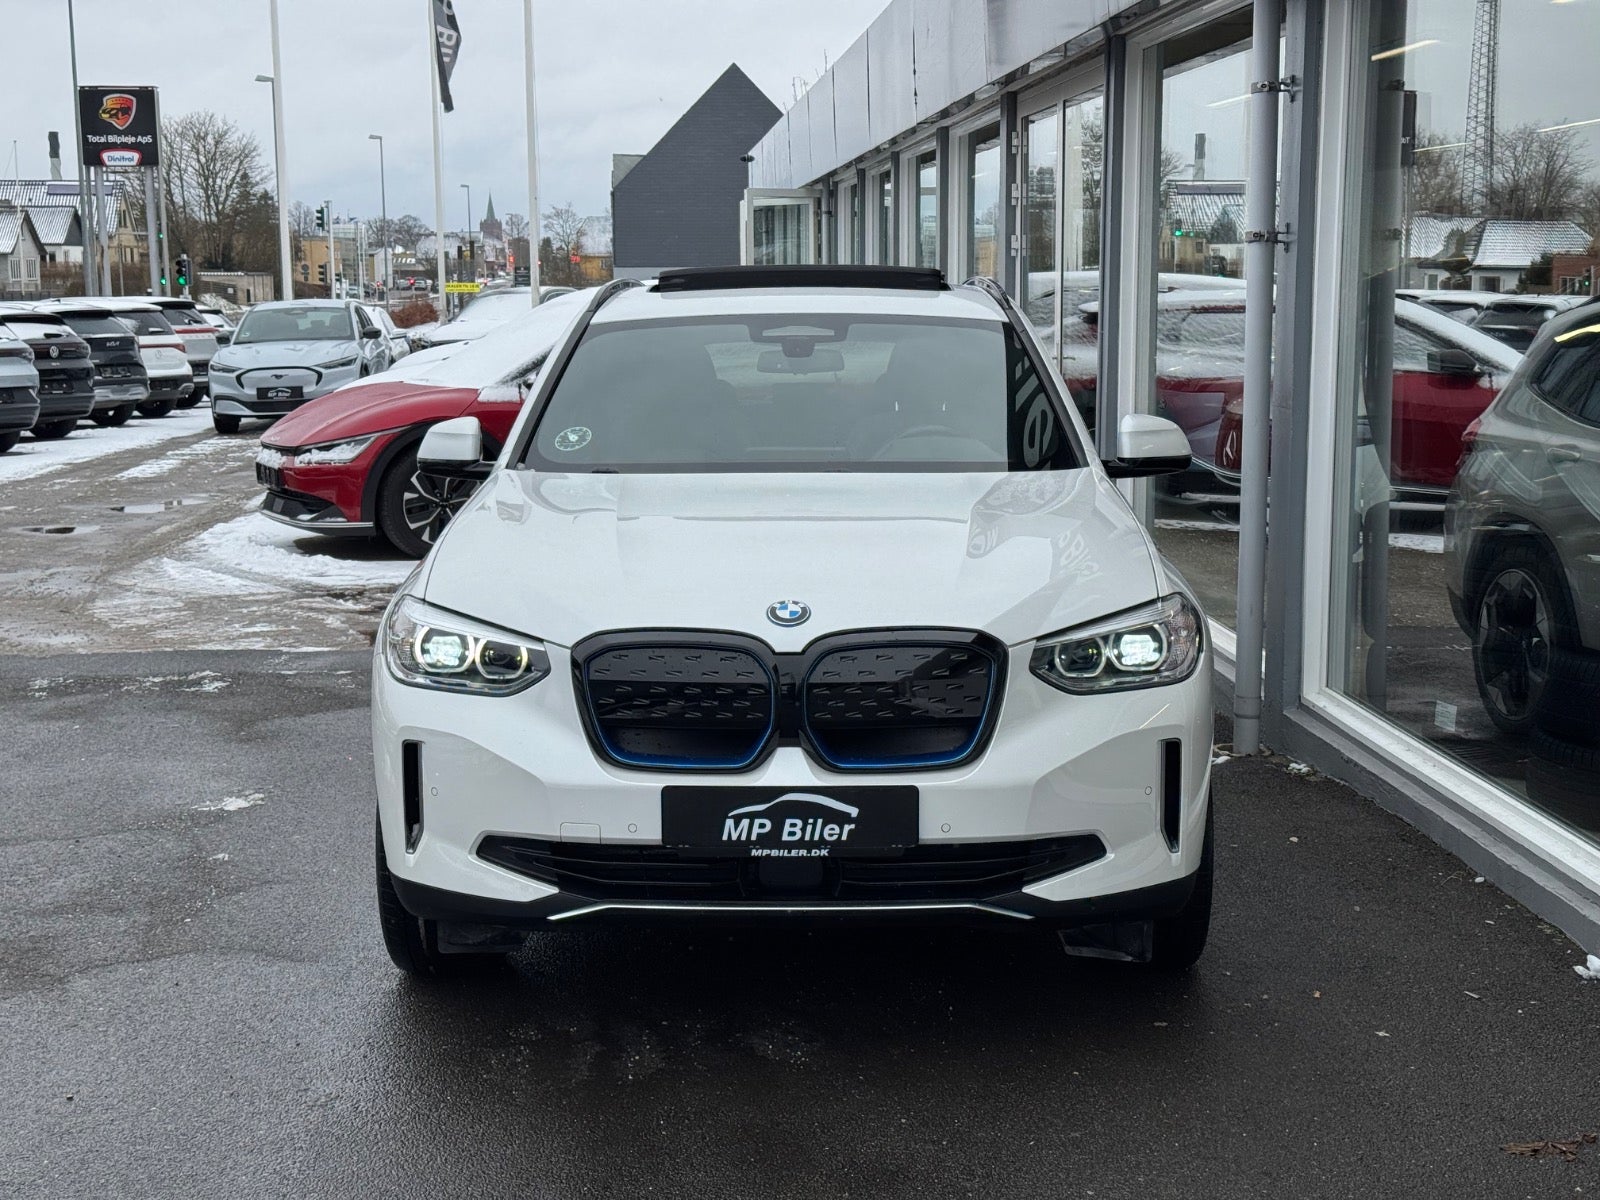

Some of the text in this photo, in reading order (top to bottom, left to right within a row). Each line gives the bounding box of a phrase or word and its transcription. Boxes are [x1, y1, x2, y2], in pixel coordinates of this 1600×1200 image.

[87, 135, 153, 144] Total Bilpleje ApS
[722, 818, 856, 841] MP Biler
[751, 848, 830, 857] MPBILER.DK
